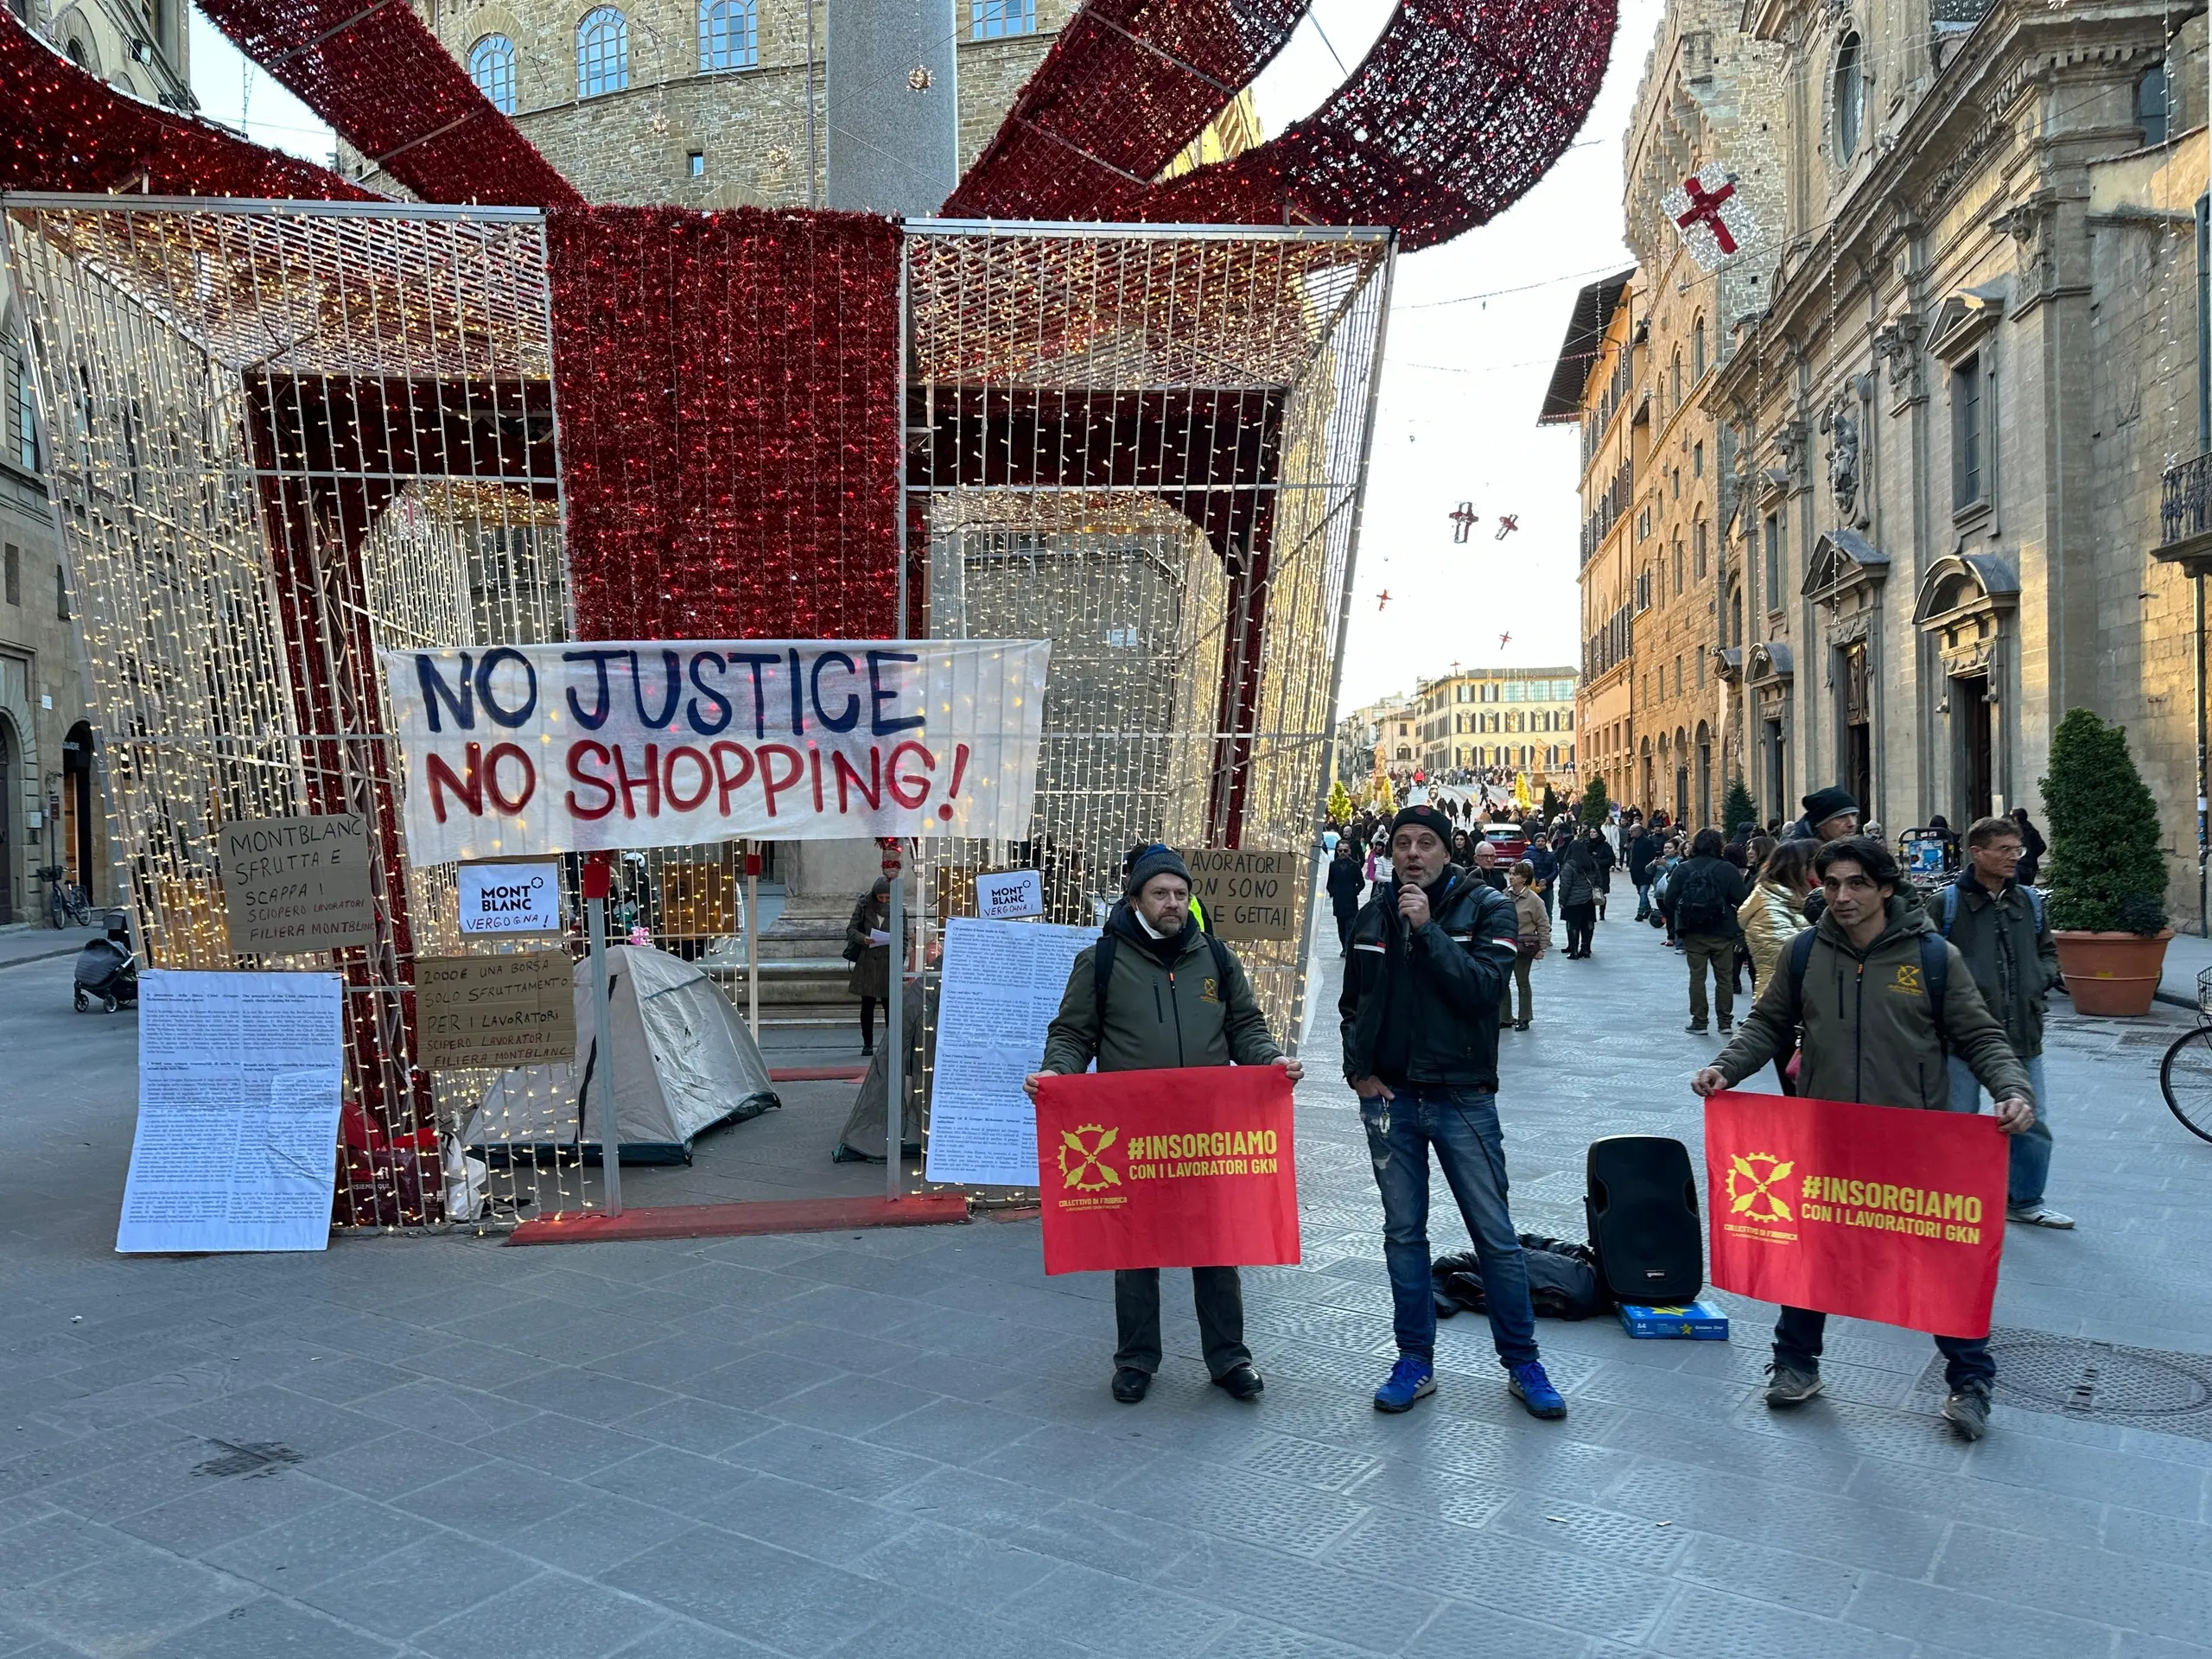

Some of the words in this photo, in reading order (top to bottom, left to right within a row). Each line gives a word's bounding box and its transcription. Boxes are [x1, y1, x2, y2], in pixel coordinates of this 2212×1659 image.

[415, 648, 537, 733] NO
[562, 648, 926, 739] JUSTICE
[426, 741, 537, 823] NO
[564, 740, 969, 822] SHOPPING!
[231, 818, 361, 856] MONTBLANC
[235, 852, 320, 886] SFRUTTA
[331, 849, 340, 864] E
[245, 883, 308, 906] SCAPPA
[481, 886, 531, 899] MONT
[991, 886, 1024, 896] MONT
[1191, 878, 1218, 896] ON
[1228, 878, 1278, 898] SONO
[247, 906, 307, 923] SCIOPERO
[314, 899, 365, 912] LAVORATORI
[482, 899, 531, 912] BLANC
[992, 895, 1025, 906] BLANC
[1213, 906, 1225, 923] E
[1234, 905, 1287, 931] GETTA!
[250, 924, 305, 942] FILIERA
[424, 968, 467, 984] 2000€
[480, 964, 503, 977] UNA
[511, 959, 549, 974] BORSA
[424, 990, 460, 1007] SOLO
[468, 977, 569, 1002] SFRUTTAMENTO
[428, 1014, 461, 1035] PER
[427, 1039, 471, 1052] SCIPERO
[481, 1032, 551, 1047] LAVORATORI
[434, 1053, 487, 1067] FILIERA
[495, 1046, 568, 1061] MONTBLANC
[1128, 1129, 1277, 1160] #INSORGIAMO
[1128, 1164, 1156, 1180] CON
[1160, 1164, 1164, 1179] I
[1168, 1161, 1248, 1179] LAVORATORI
[1251, 1159, 1278, 1174] GKN
[1802, 1175, 1982, 1224] #INSORGIAMO
[1802, 1203, 1832, 1223] CON
[1835, 1207, 1840, 1224] I
[1845, 1208, 1942, 1238] LAVORATORI
[1944, 1223, 1980, 1244] GKN
